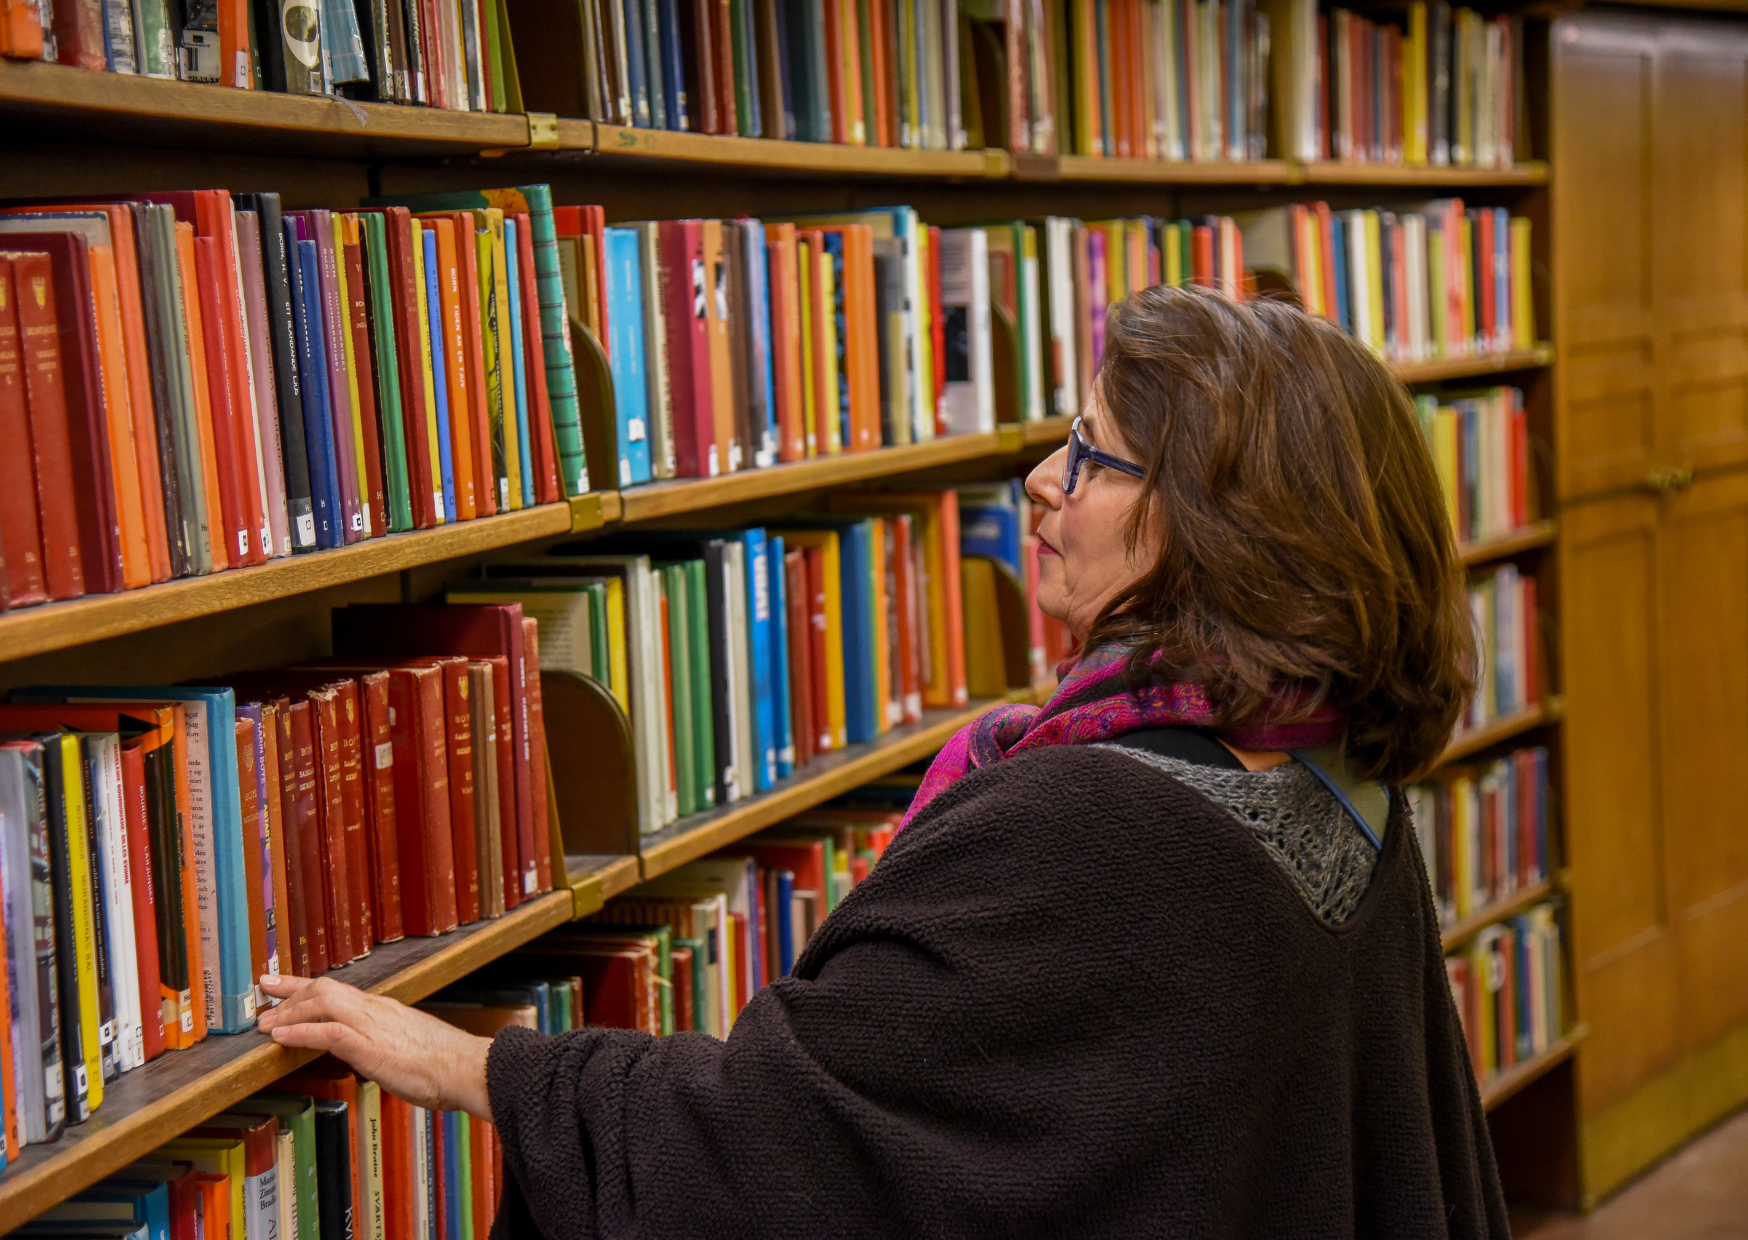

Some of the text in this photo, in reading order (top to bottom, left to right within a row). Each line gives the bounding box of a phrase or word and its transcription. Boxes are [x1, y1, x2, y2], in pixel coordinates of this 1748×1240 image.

[458, 350, 463, 363] EN
[113, 743, 121, 782] MADELEINE
[374, 1190, 382, 1240] SVARTS
